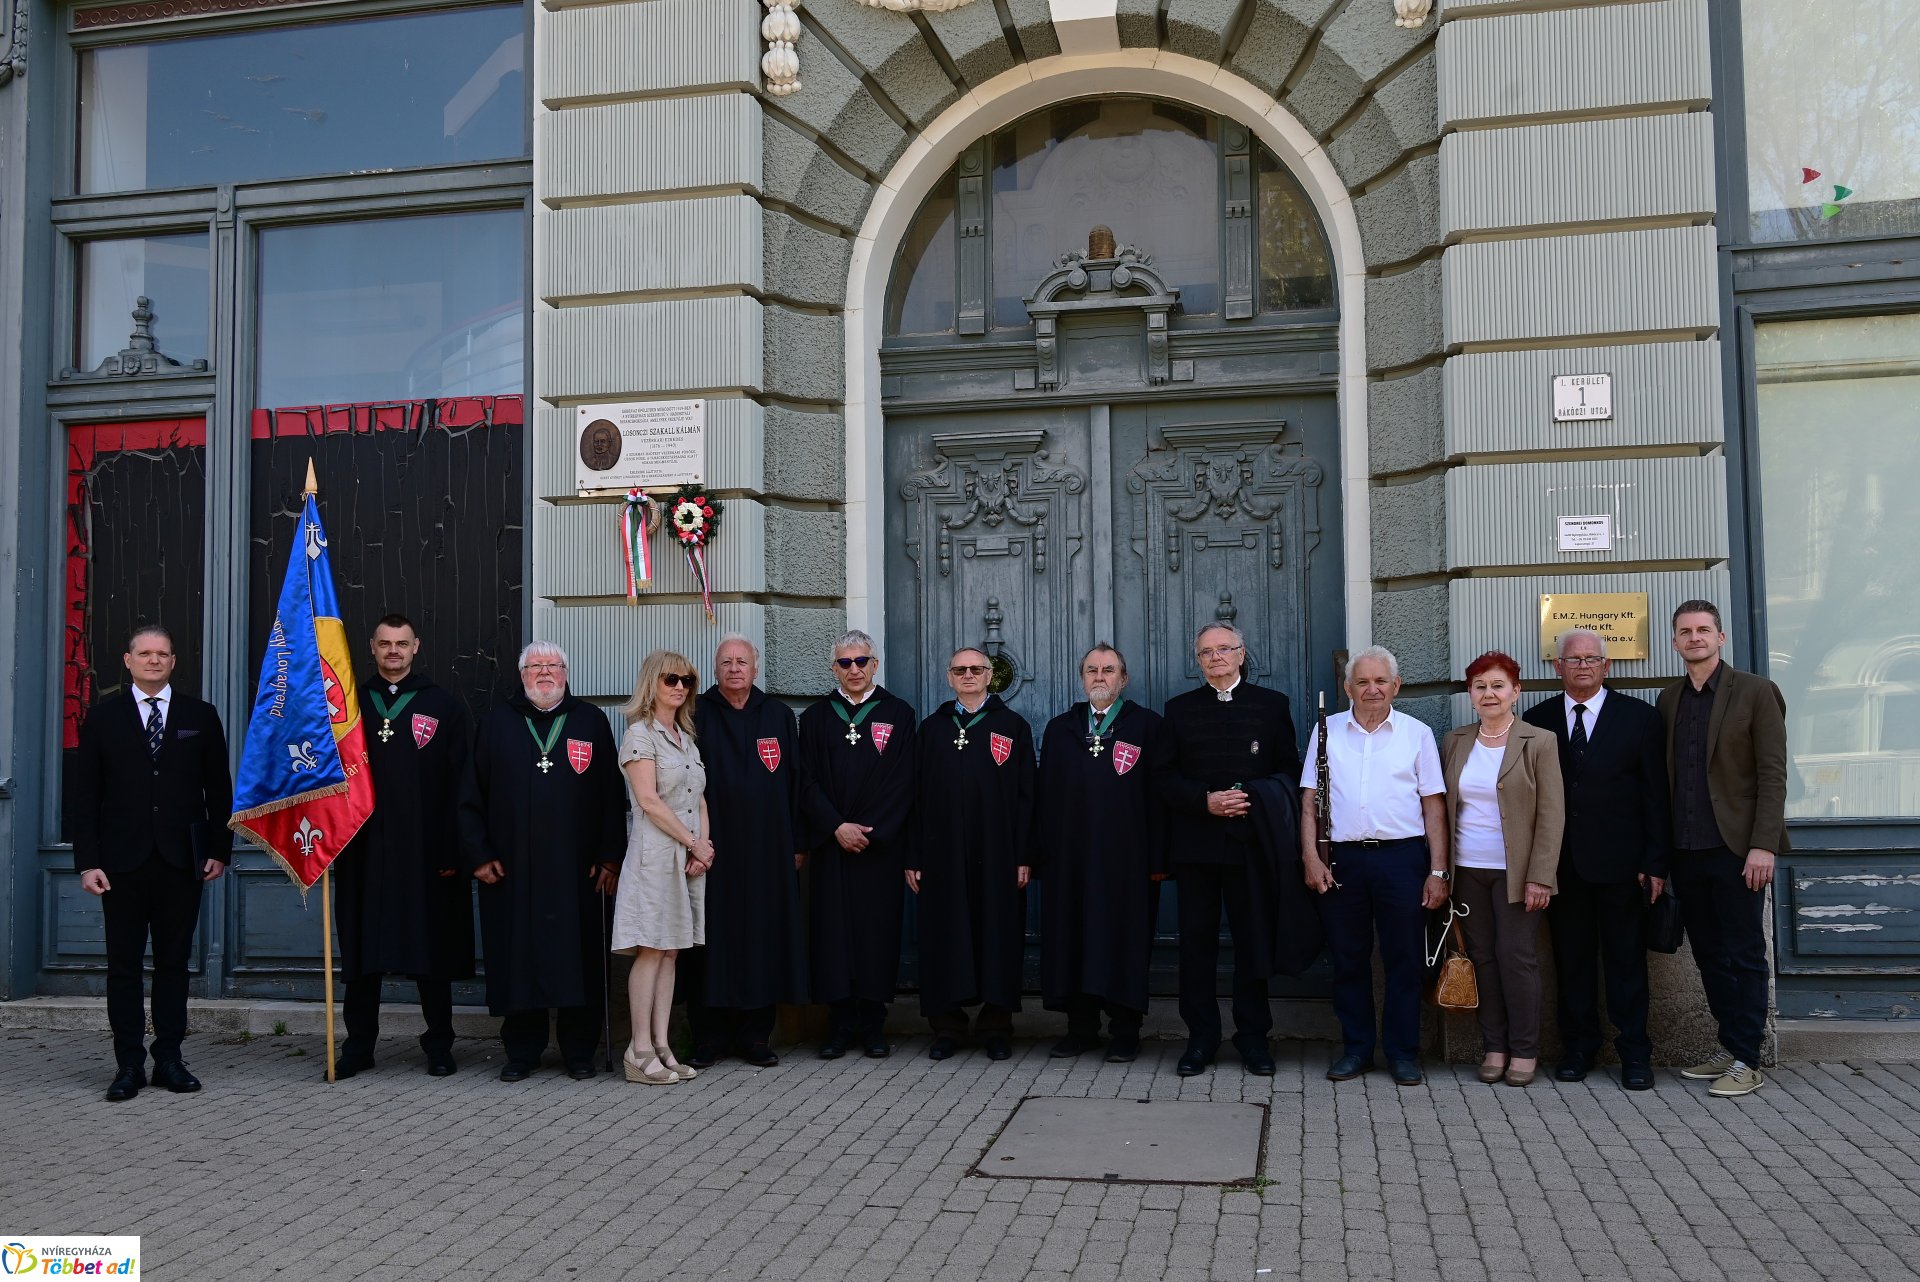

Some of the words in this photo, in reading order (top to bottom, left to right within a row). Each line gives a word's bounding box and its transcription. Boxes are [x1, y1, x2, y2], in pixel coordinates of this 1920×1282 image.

[1571, 376, 1604, 386] KERÜLET
[1579, 387, 1586, 406] 1
[1558, 406, 1586, 416] RÁKÓCZI
[1591, 406, 1608, 415] UTCA
[649, 427, 675, 436] SZAKALL
[675, 425, 701, 434] KÁLMÁN
[1553, 612, 1578, 620] E.M.Z.
[1579, 612, 1619, 621] Hungary
[1621, 611, 1636, 619] Kft.
[1599, 623, 1615, 631] Kft.
[269, 651, 291, 718] Lovagrend
